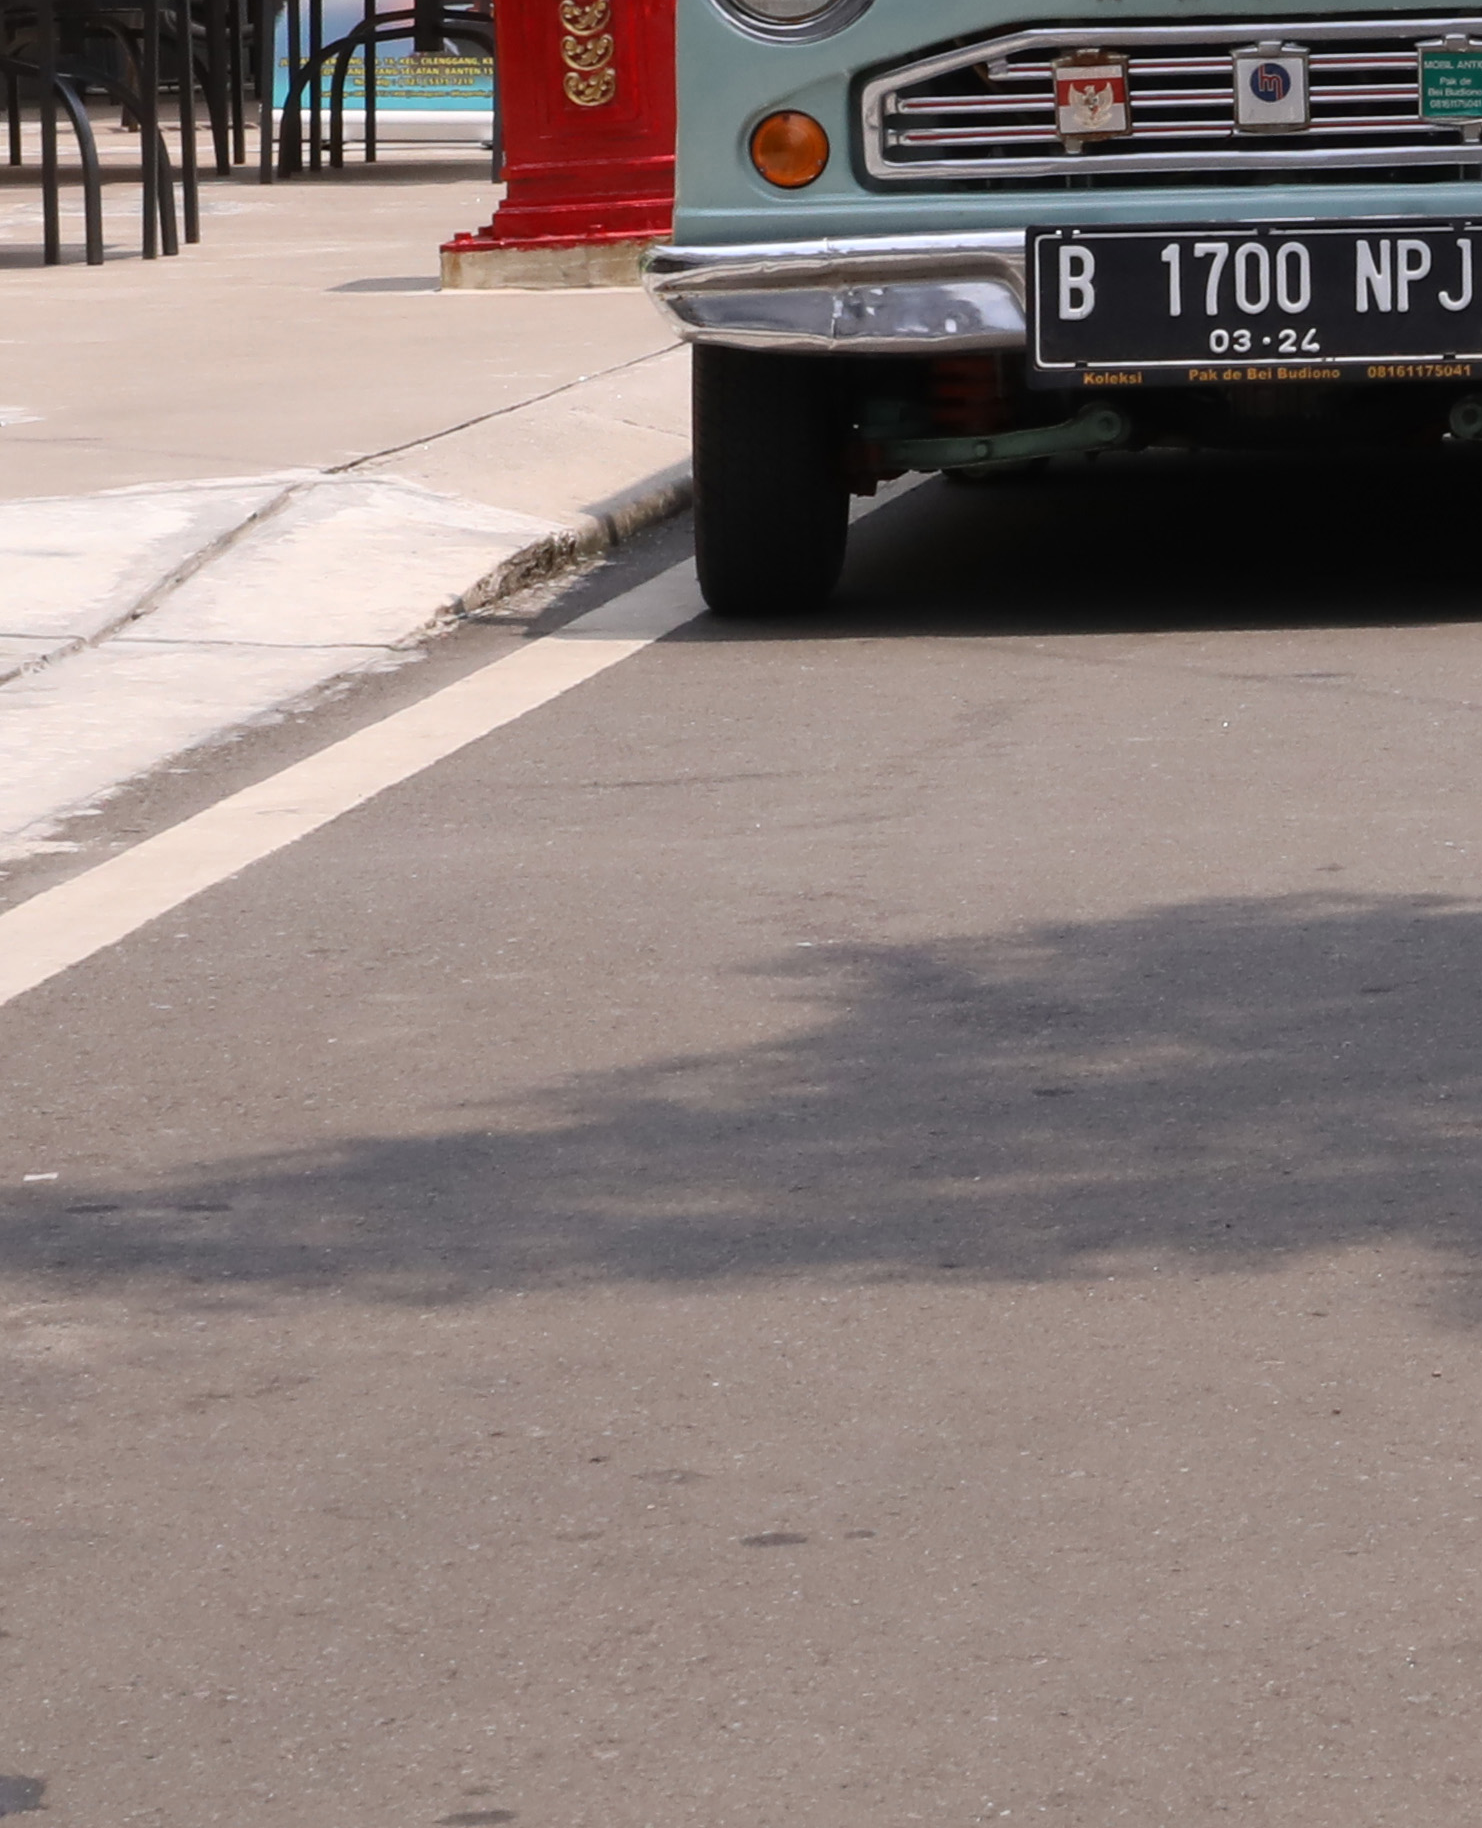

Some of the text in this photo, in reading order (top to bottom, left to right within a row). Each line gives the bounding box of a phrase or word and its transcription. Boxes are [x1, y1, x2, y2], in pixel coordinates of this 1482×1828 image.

[1059, 238, 1473, 320] B 1700 NPJ
[1083, 365, 1472, 385] Koleksi Pak de Bei Budiono 08161175041
